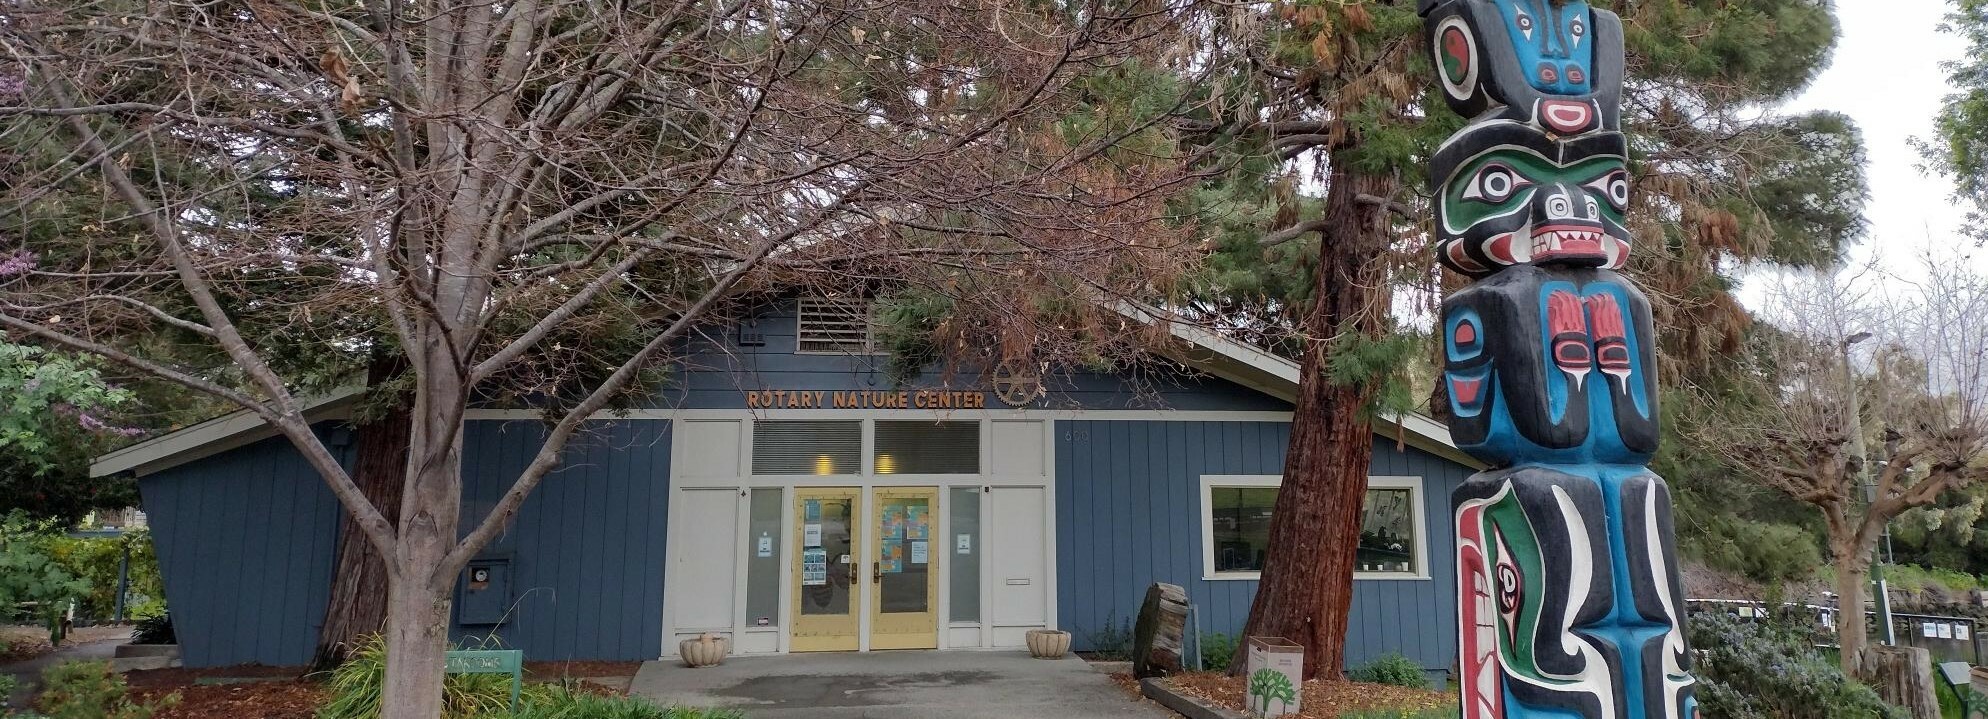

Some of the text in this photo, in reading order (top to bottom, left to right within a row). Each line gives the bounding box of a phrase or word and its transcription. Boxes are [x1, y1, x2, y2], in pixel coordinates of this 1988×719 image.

[747, 390, 985, 408] ROTARY NATURE CENTER
